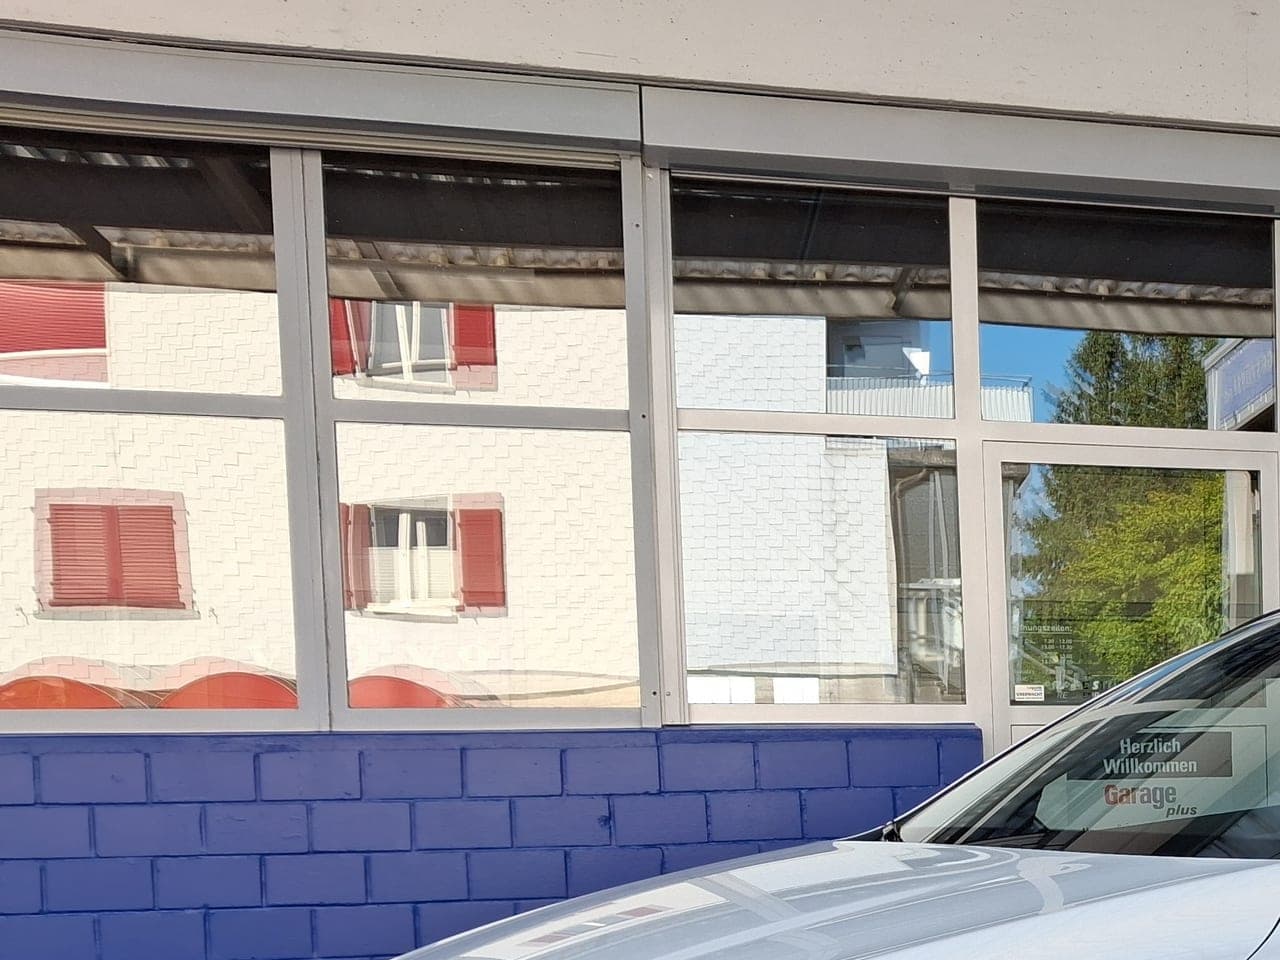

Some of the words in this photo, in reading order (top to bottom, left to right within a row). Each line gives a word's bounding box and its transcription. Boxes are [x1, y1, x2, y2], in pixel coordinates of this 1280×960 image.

[1120, 737, 1181, 754] Herzlich
[1103, 757, 1197, 775] Willkommen
[1103, 784, 1177, 810] Garage
[1165, 804, 1198, 818] plus
